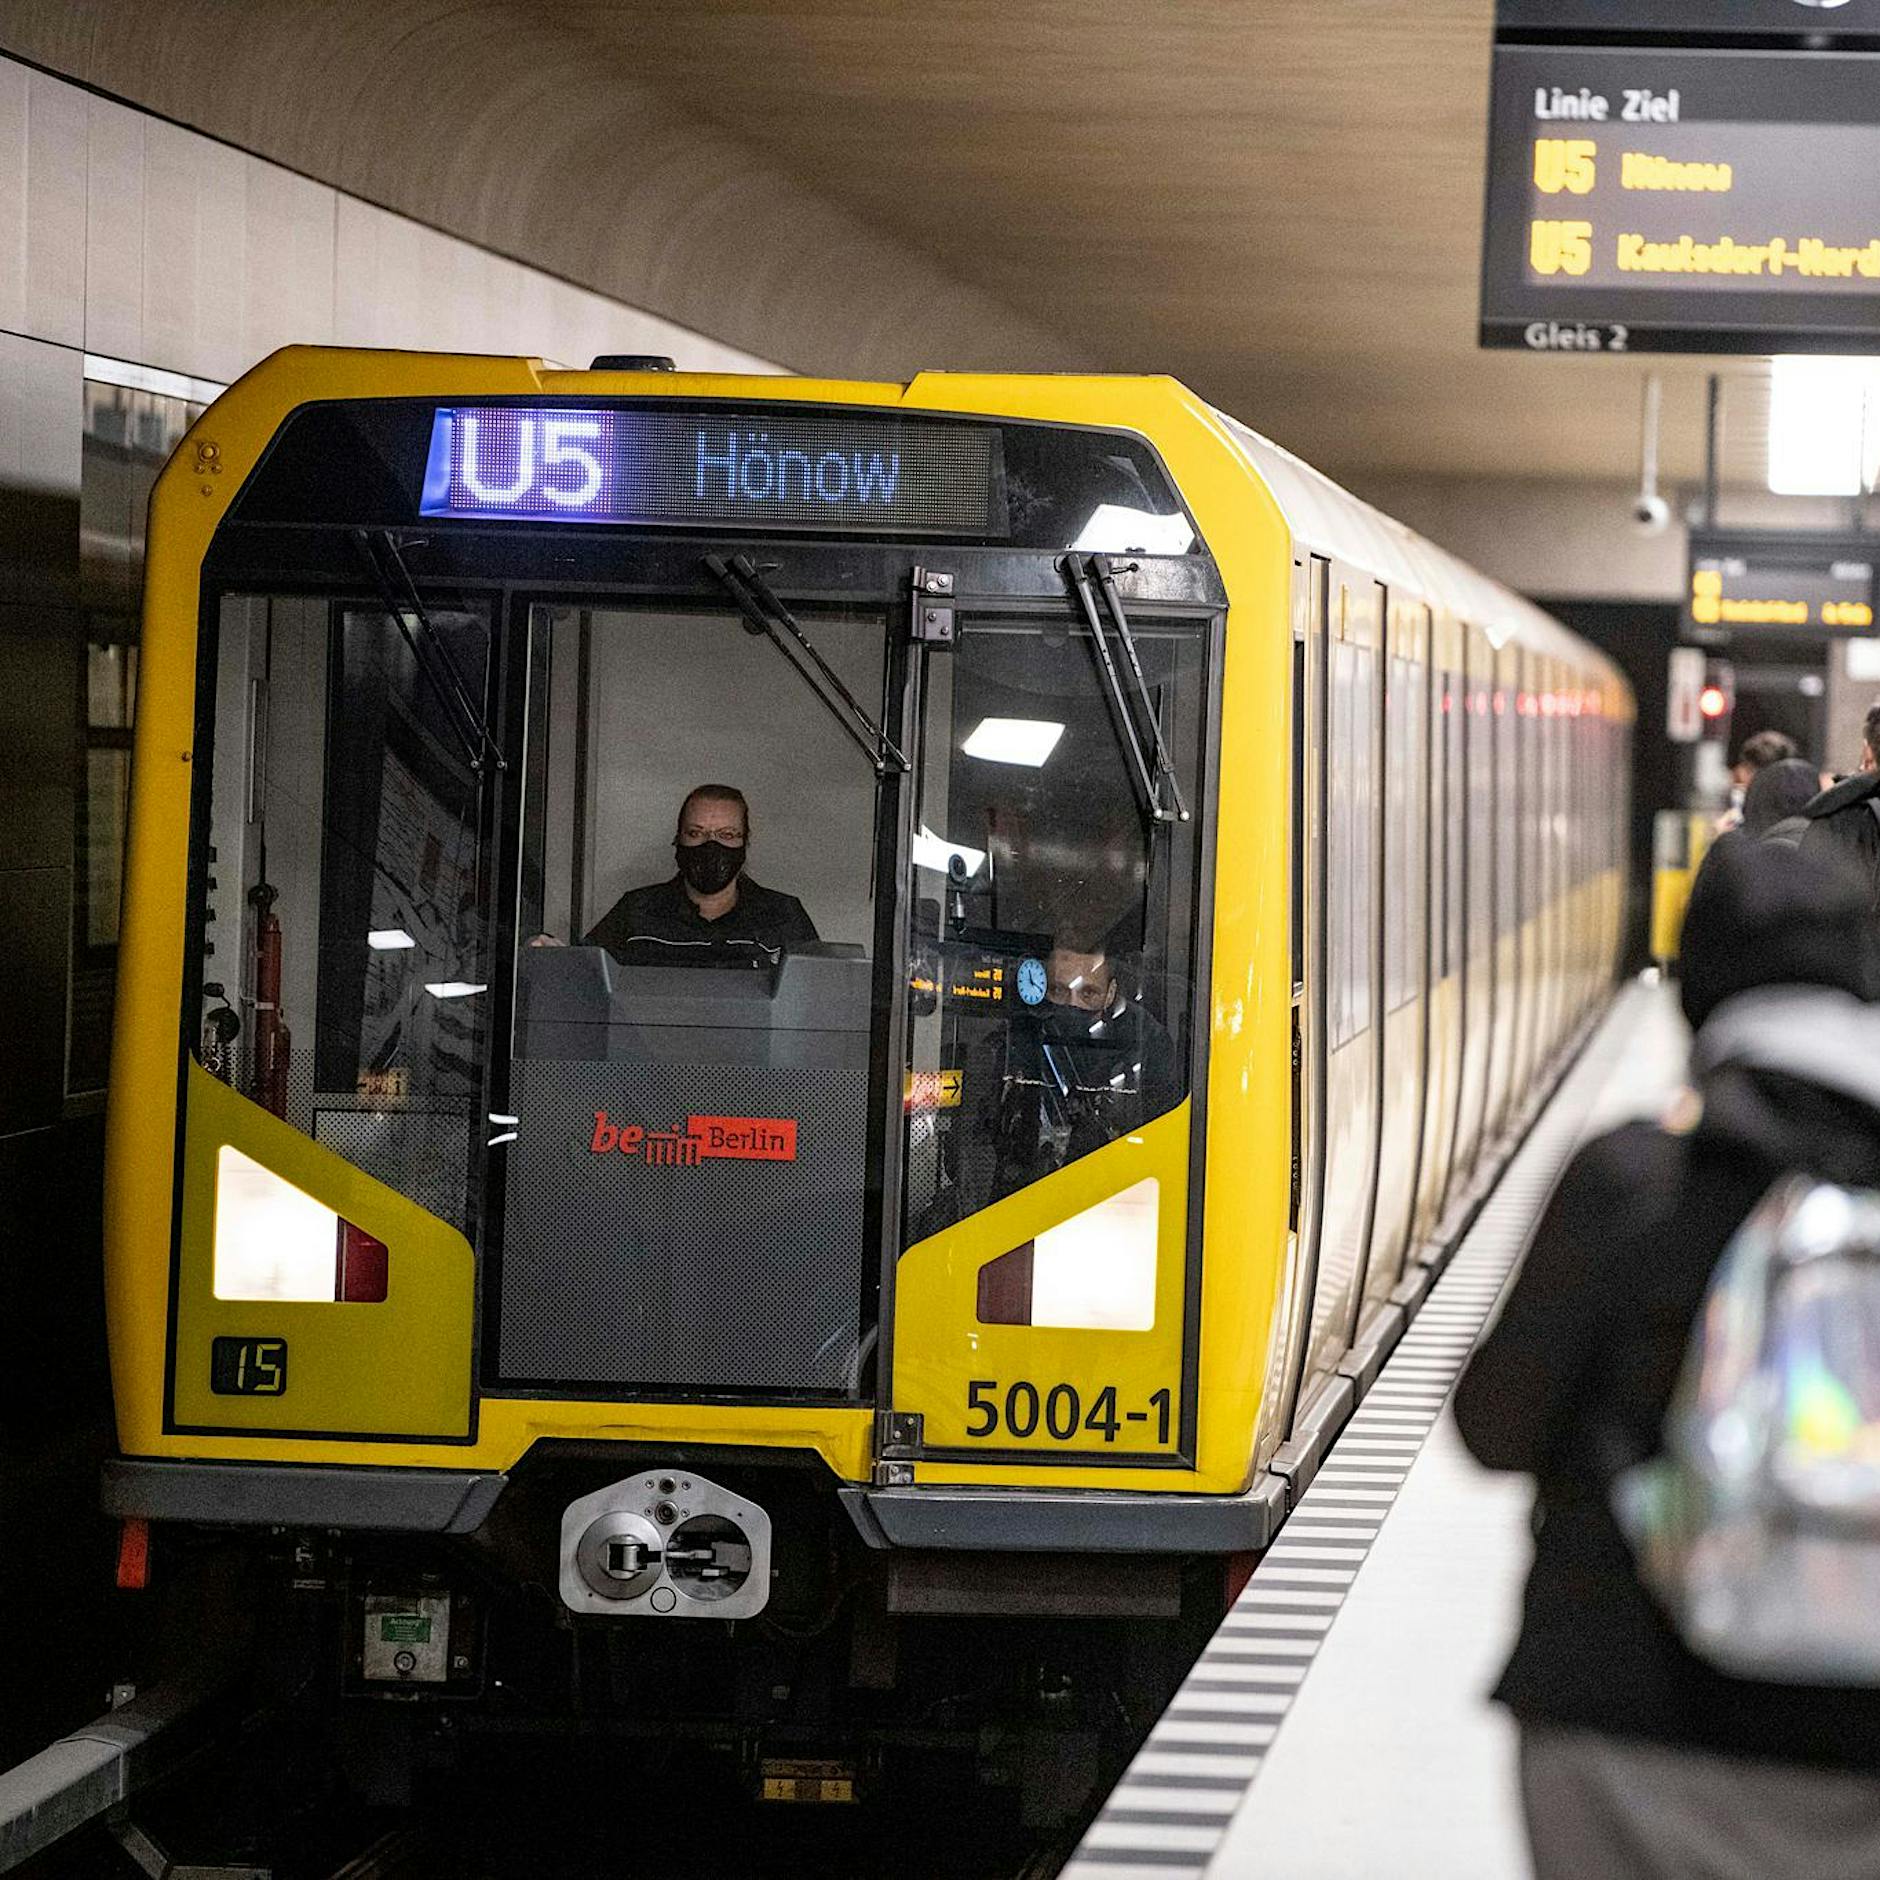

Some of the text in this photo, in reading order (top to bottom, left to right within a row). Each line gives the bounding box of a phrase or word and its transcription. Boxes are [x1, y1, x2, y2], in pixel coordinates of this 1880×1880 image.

[1534, 87, 1680, 122] Linie Ziel
[1533, 138, 1597, 194] U5
[1530, 219, 1593, 275] U5
[1524, 322, 1629, 350] Gleis 2
[461, 413, 900, 506] U5 Hönow
[589, 1109, 785, 1155] be Berlin
[236, 1343, 282, 1391] 15
[966, 1380, 1170, 1443] 5004-1
